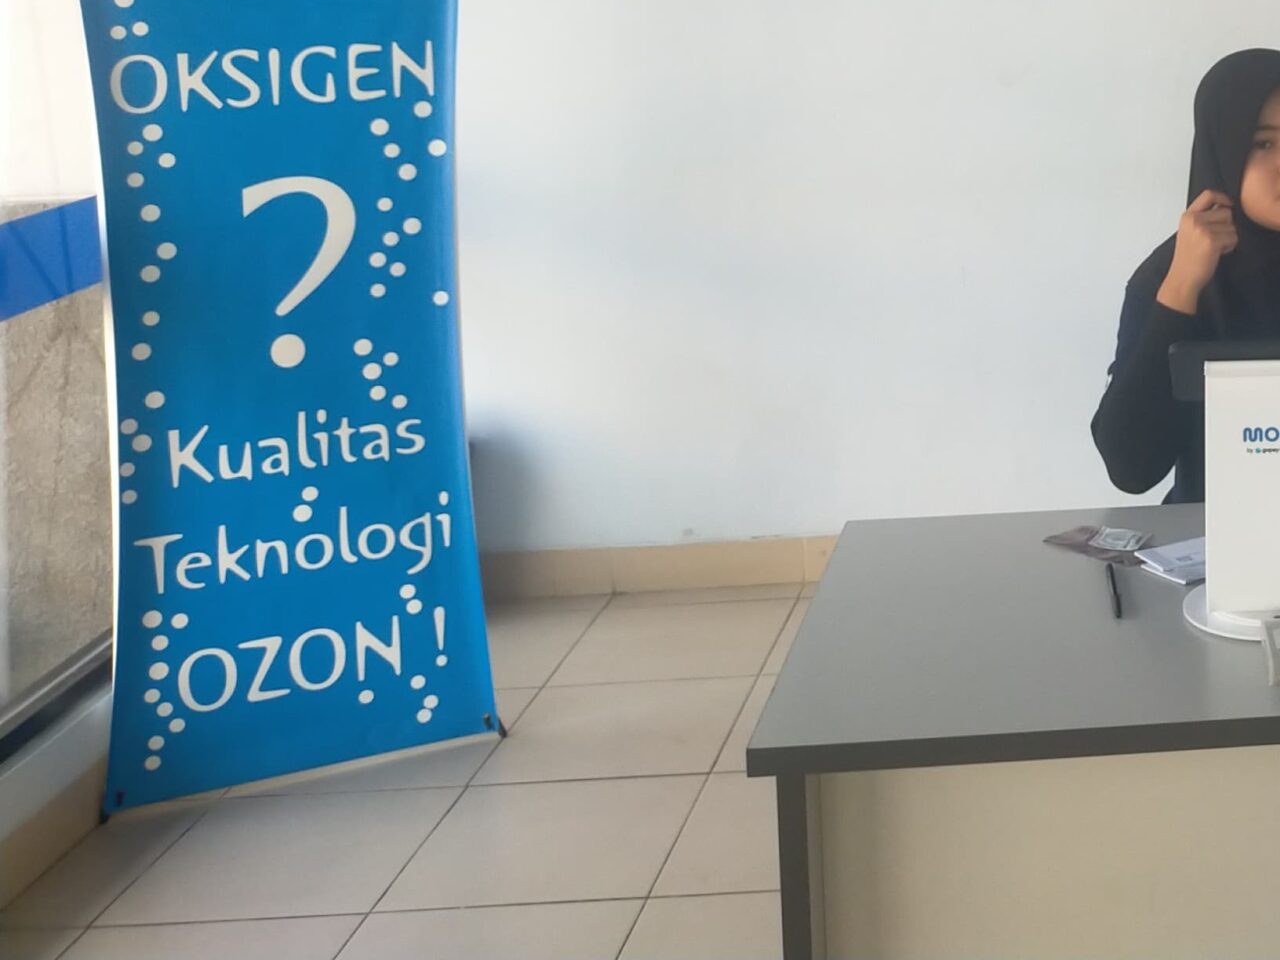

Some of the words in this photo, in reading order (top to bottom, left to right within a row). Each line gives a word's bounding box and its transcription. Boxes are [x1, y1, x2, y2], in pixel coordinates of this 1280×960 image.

[110, 40, 436, 114] OKSIGEN
[241, 175, 356, 369] ?
[167, 408, 426, 489] Kualitas
[133, 490, 452, 595] Teknologi
[177, 614, 402, 712] OZON
